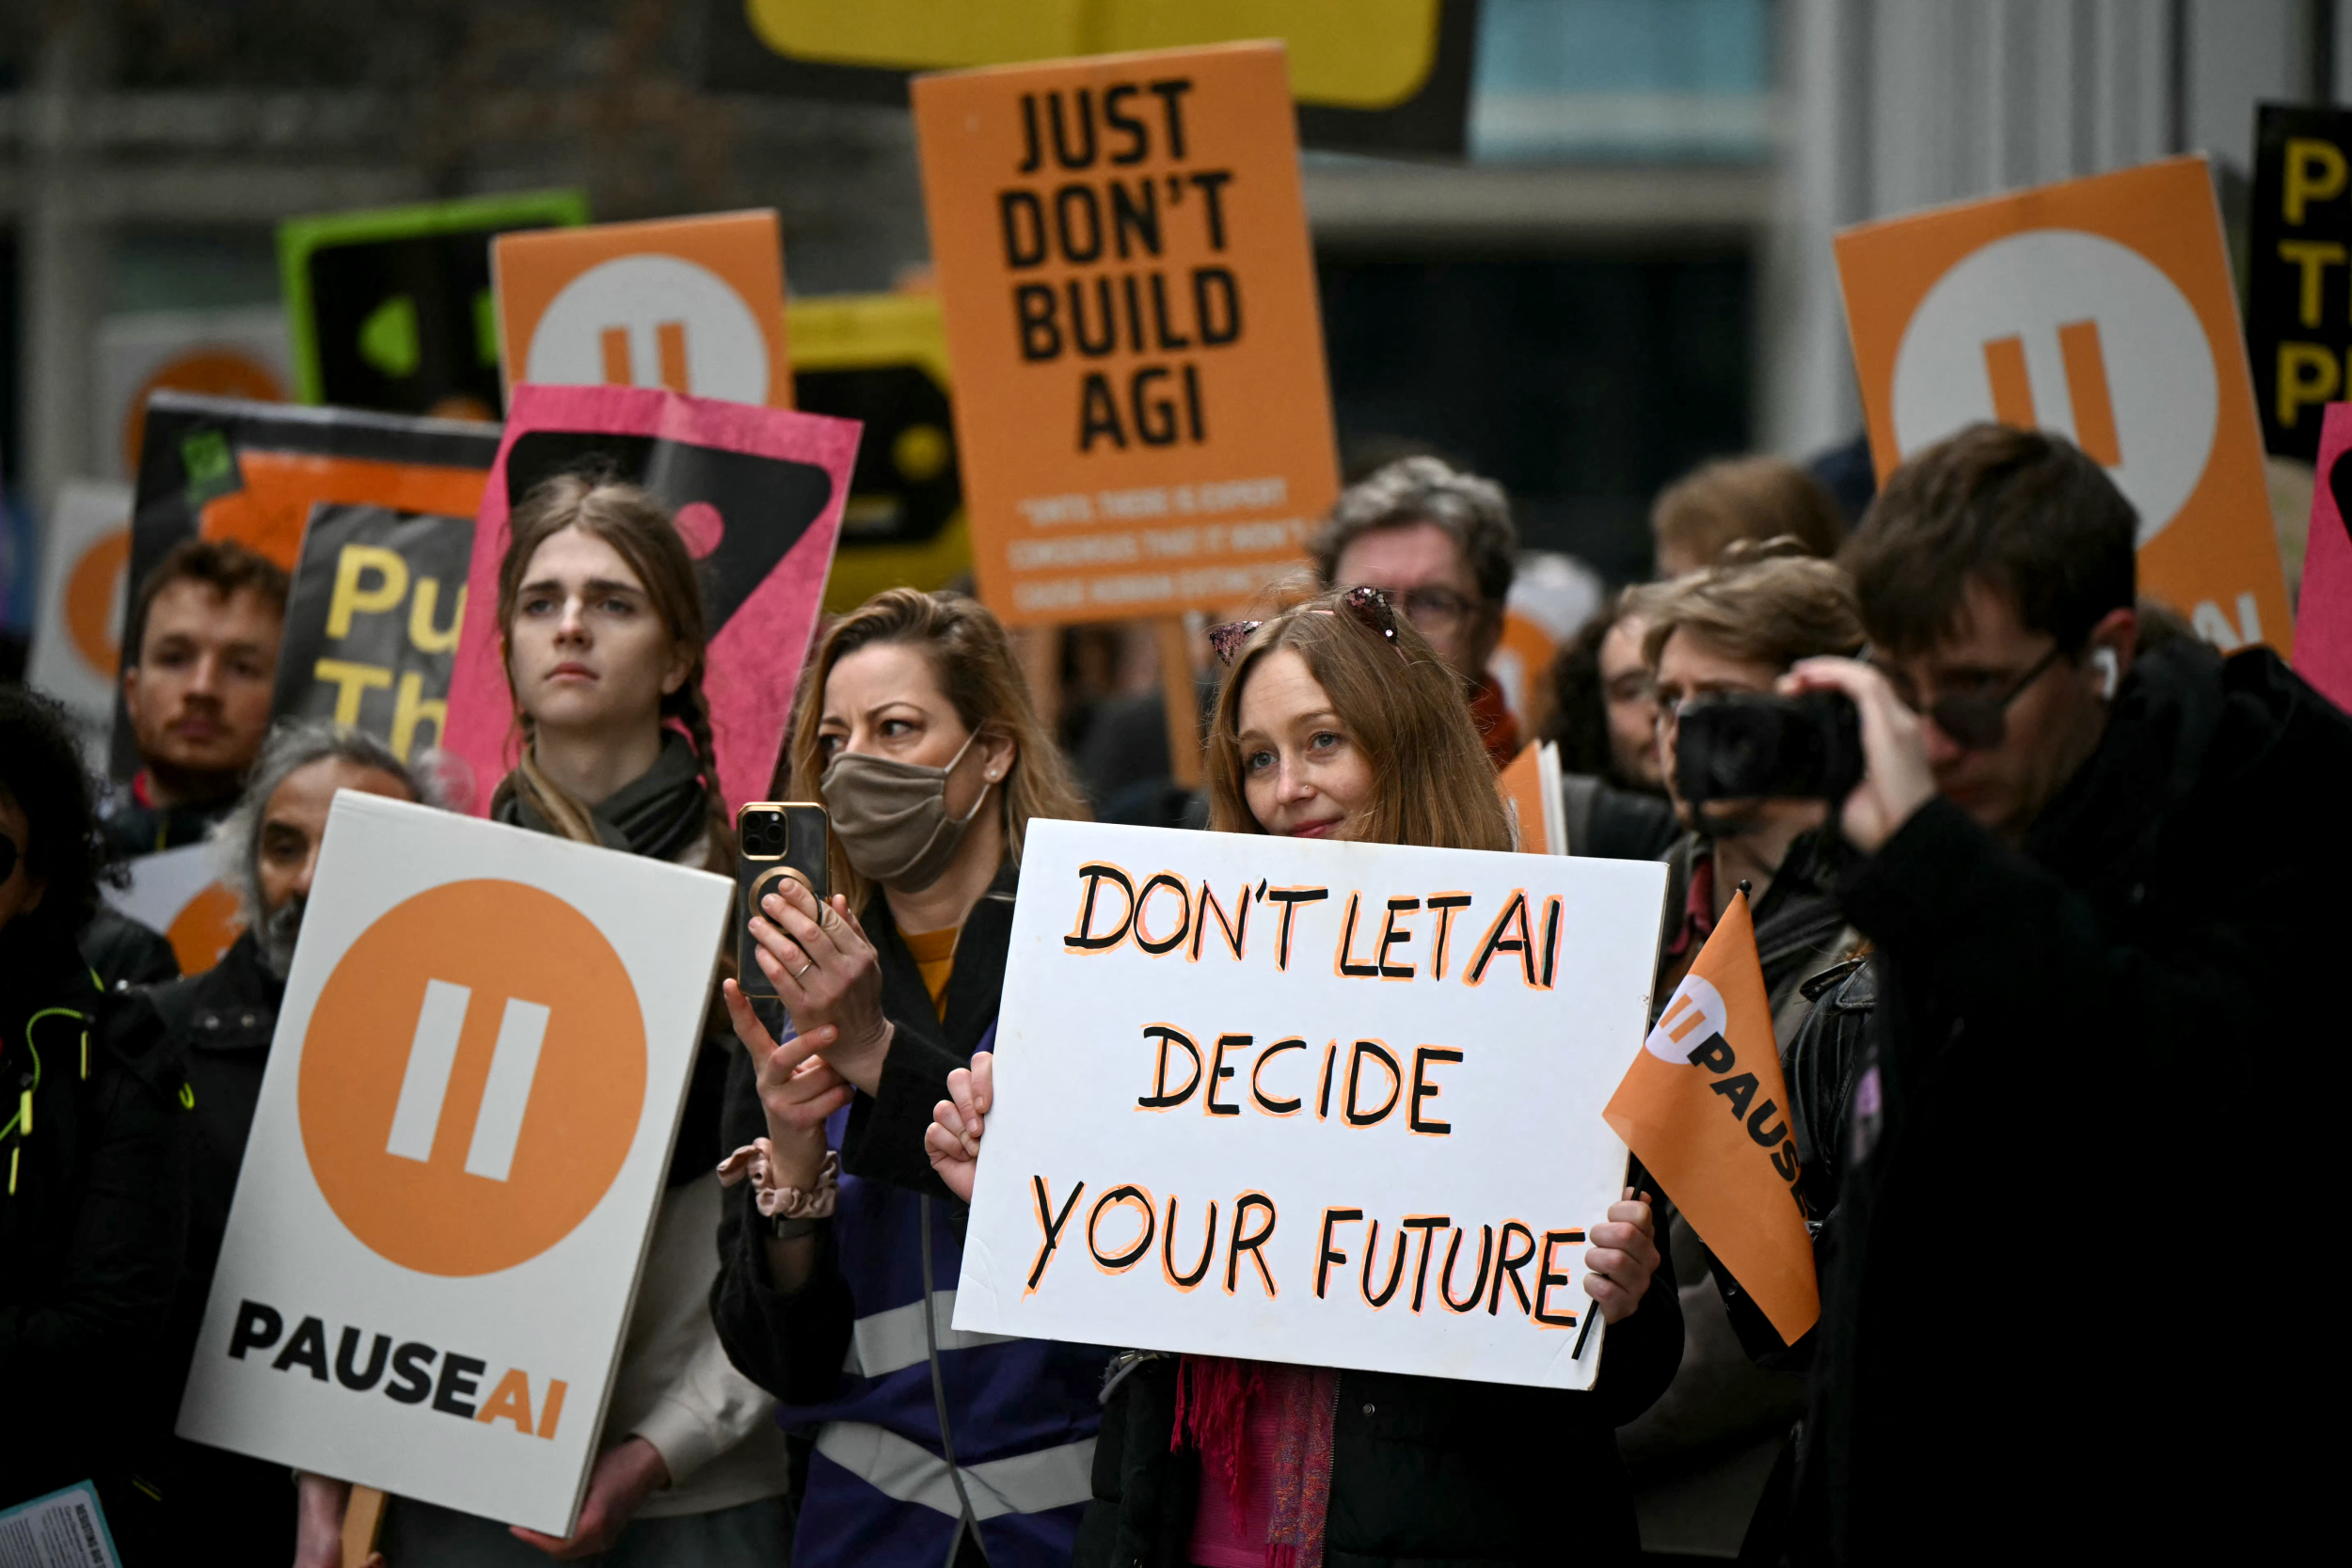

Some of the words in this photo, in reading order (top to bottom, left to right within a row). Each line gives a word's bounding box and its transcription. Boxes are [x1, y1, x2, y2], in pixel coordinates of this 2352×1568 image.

[1018, 79, 1193, 173] JUST
[998, 171, 1232, 269] DON'T
[2281, 137, 2352, 226] P
[1013, 266, 1243, 363] BUILD
[2277, 239, 2352, 329] T
[1078, 362, 1205, 452] AGI
[1063, 861, 1327, 972] DON'T
[1334, 889, 1471, 981] LET
[1463, 888, 1563, 990] AI
[1135, 1022, 1463, 1136] DECIDE
[1022, 1174, 1279, 1302] YOUR
[1314, 1206, 1585, 1329] FUTURE
[228, 1298, 568, 1441] PAUSEAI
